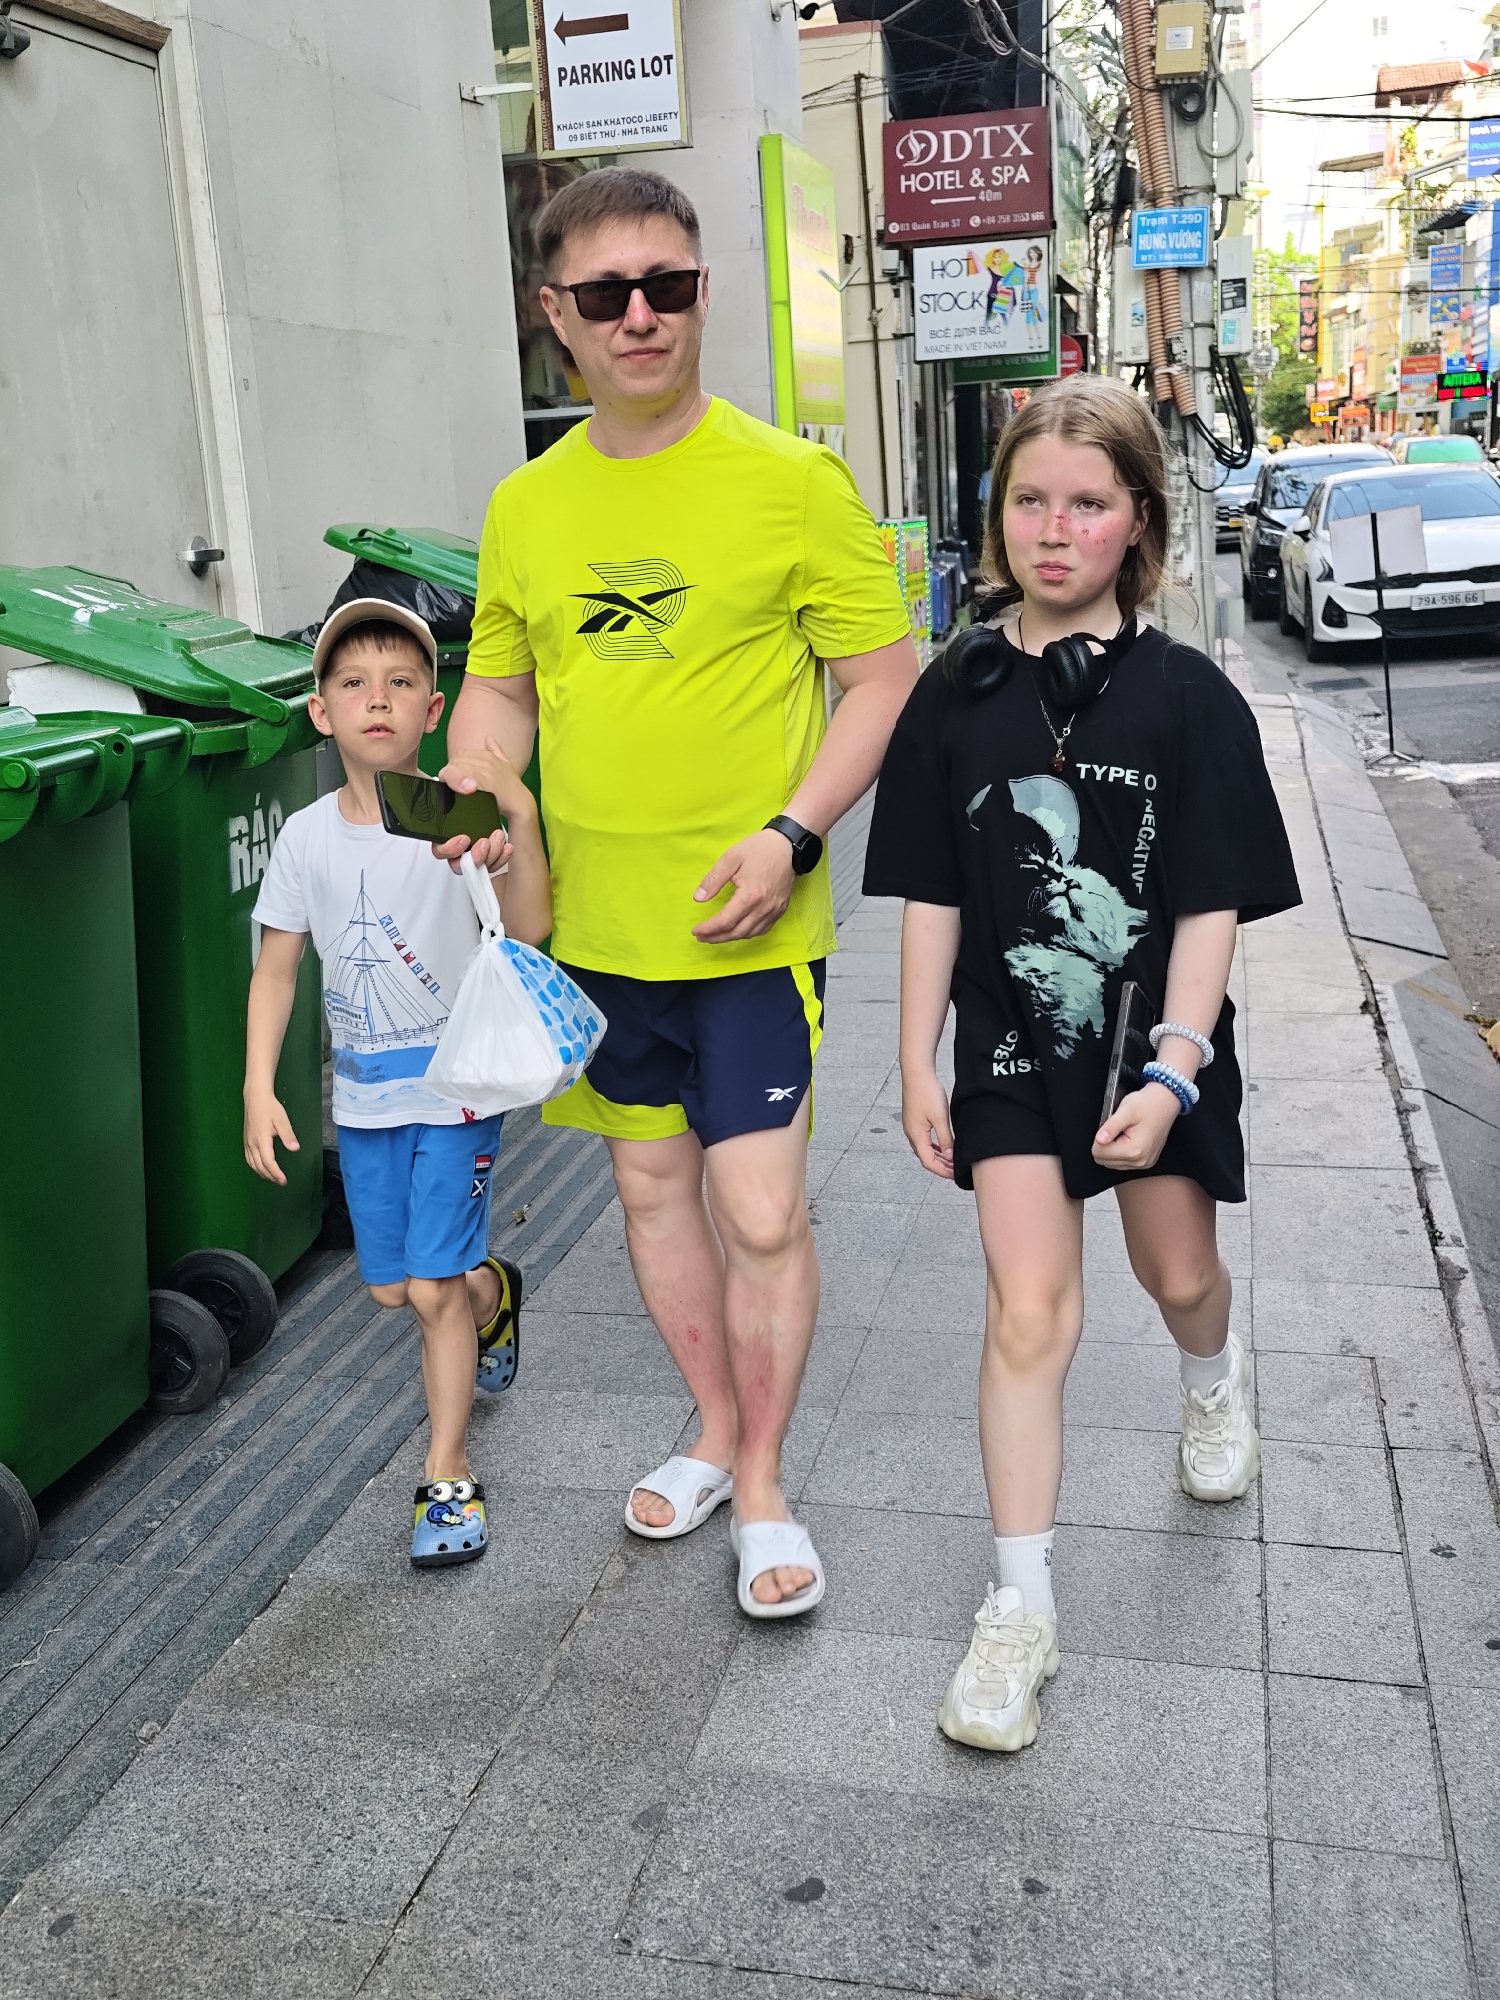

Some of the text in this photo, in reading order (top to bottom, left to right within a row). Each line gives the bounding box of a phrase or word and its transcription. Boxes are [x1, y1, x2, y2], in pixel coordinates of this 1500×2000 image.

[557, 59, 635, 87] PARKING
[641, 54, 673, 78] LOT
[586, 119, 602, 129] SẠN
[604, 115, 643, 127] KHATOCO
[645, 111, 678, 122] LIBERTY
[569, 134, 578, 142] 09
[580, 130, 597, 141] BIỆT
[600, 129, 616, 139] THỰ
[622, 127, 638, 137] NHA
[640, 124, 668, 135] TRANG
[900, 163, 1030, 194] HOTEL & SPA
[979, 190, 1003, 202] 40m
[1139, 213, 1203, 227] Trạm T.29D
[1138, 229, 1202, 250] HÙNG VƯƠNG
[931, 258, 972, 280] HOT
[919, 290, 986, 314] STOCK
[929, 325, 1001, 339] ВСЁ ДЛЯ ВАС
[924, 344, 952, 354] MADE
[953, 343, 962, 352] IN
[1076, 763, 1157, 791] TYPE O
